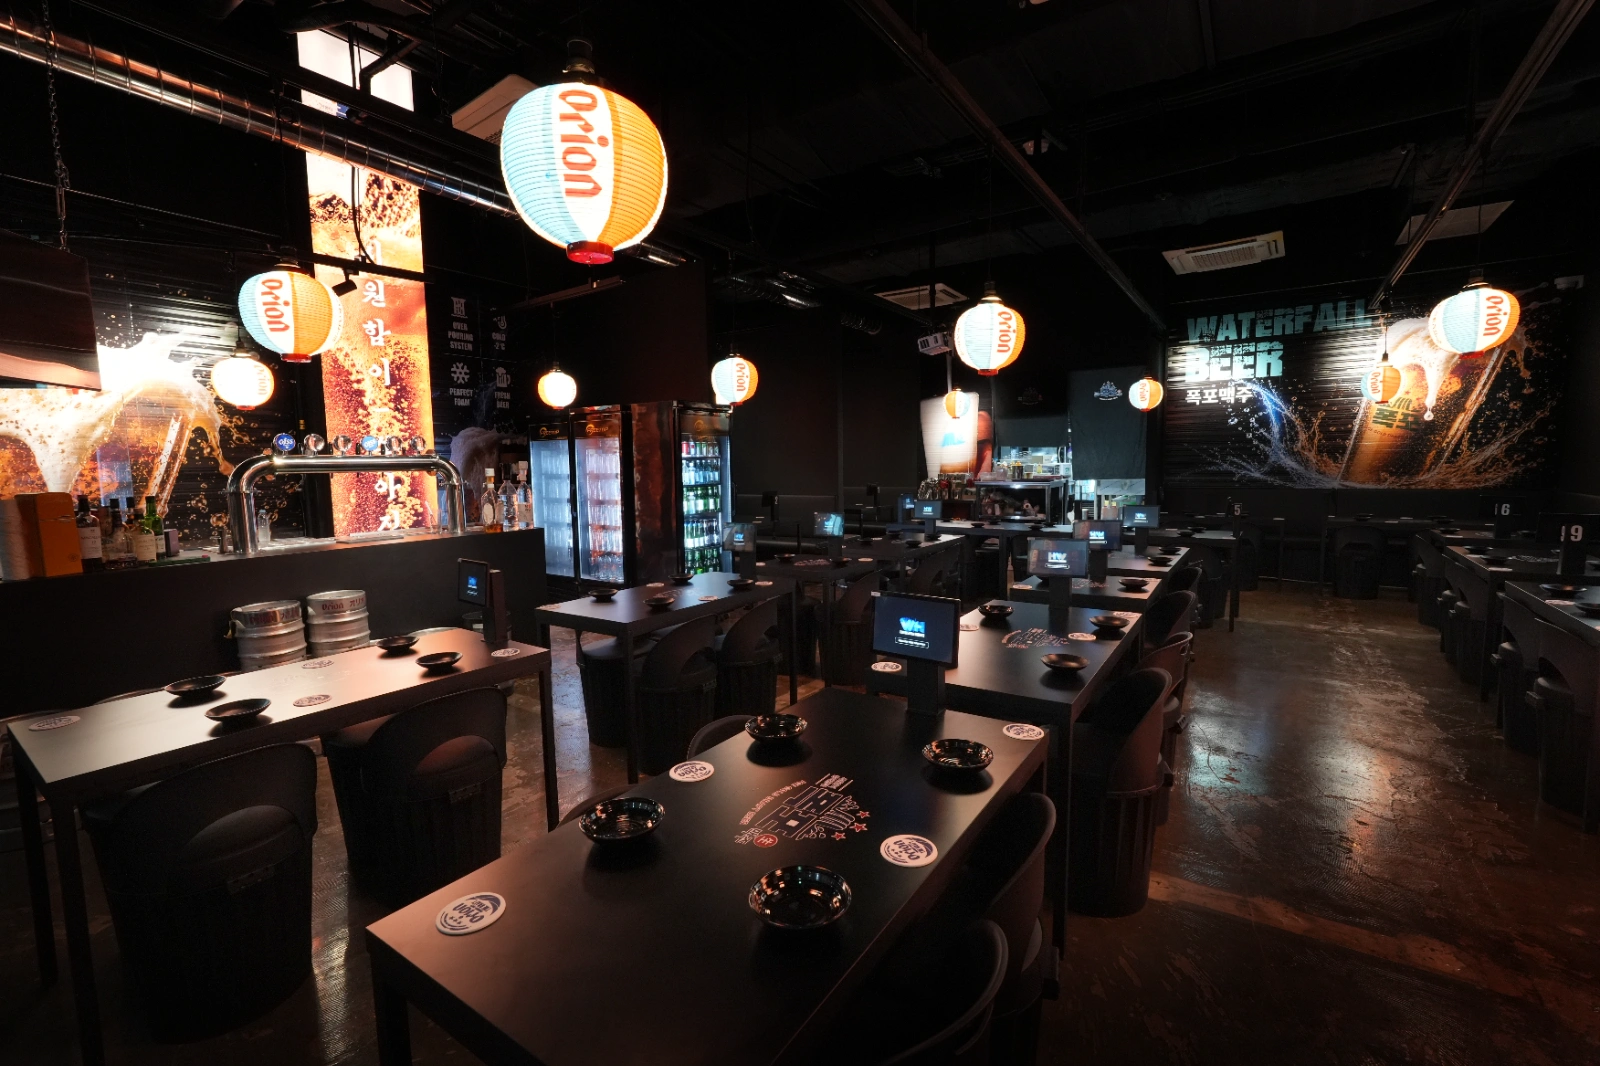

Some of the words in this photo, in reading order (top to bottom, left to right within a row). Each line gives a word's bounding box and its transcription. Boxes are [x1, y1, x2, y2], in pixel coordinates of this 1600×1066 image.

[558, 89, 609, 198] Orion
[261, 279, 290, 332] Orion
[1187, 299, 1372, 344] WATERFALL
[1483, 296, 1507, 336] Orion
[449, 341, 473, 351] SYSTEM
[997, 311, 1016, 353] Orion
[736, 363, 748, 391] Orion
[1185, 341, 1283, 382] BEER
[1234, 504, 1241, 515] 5
[322, 602, 344, 610] Orion
[452, 903, 485, 924] Orion
